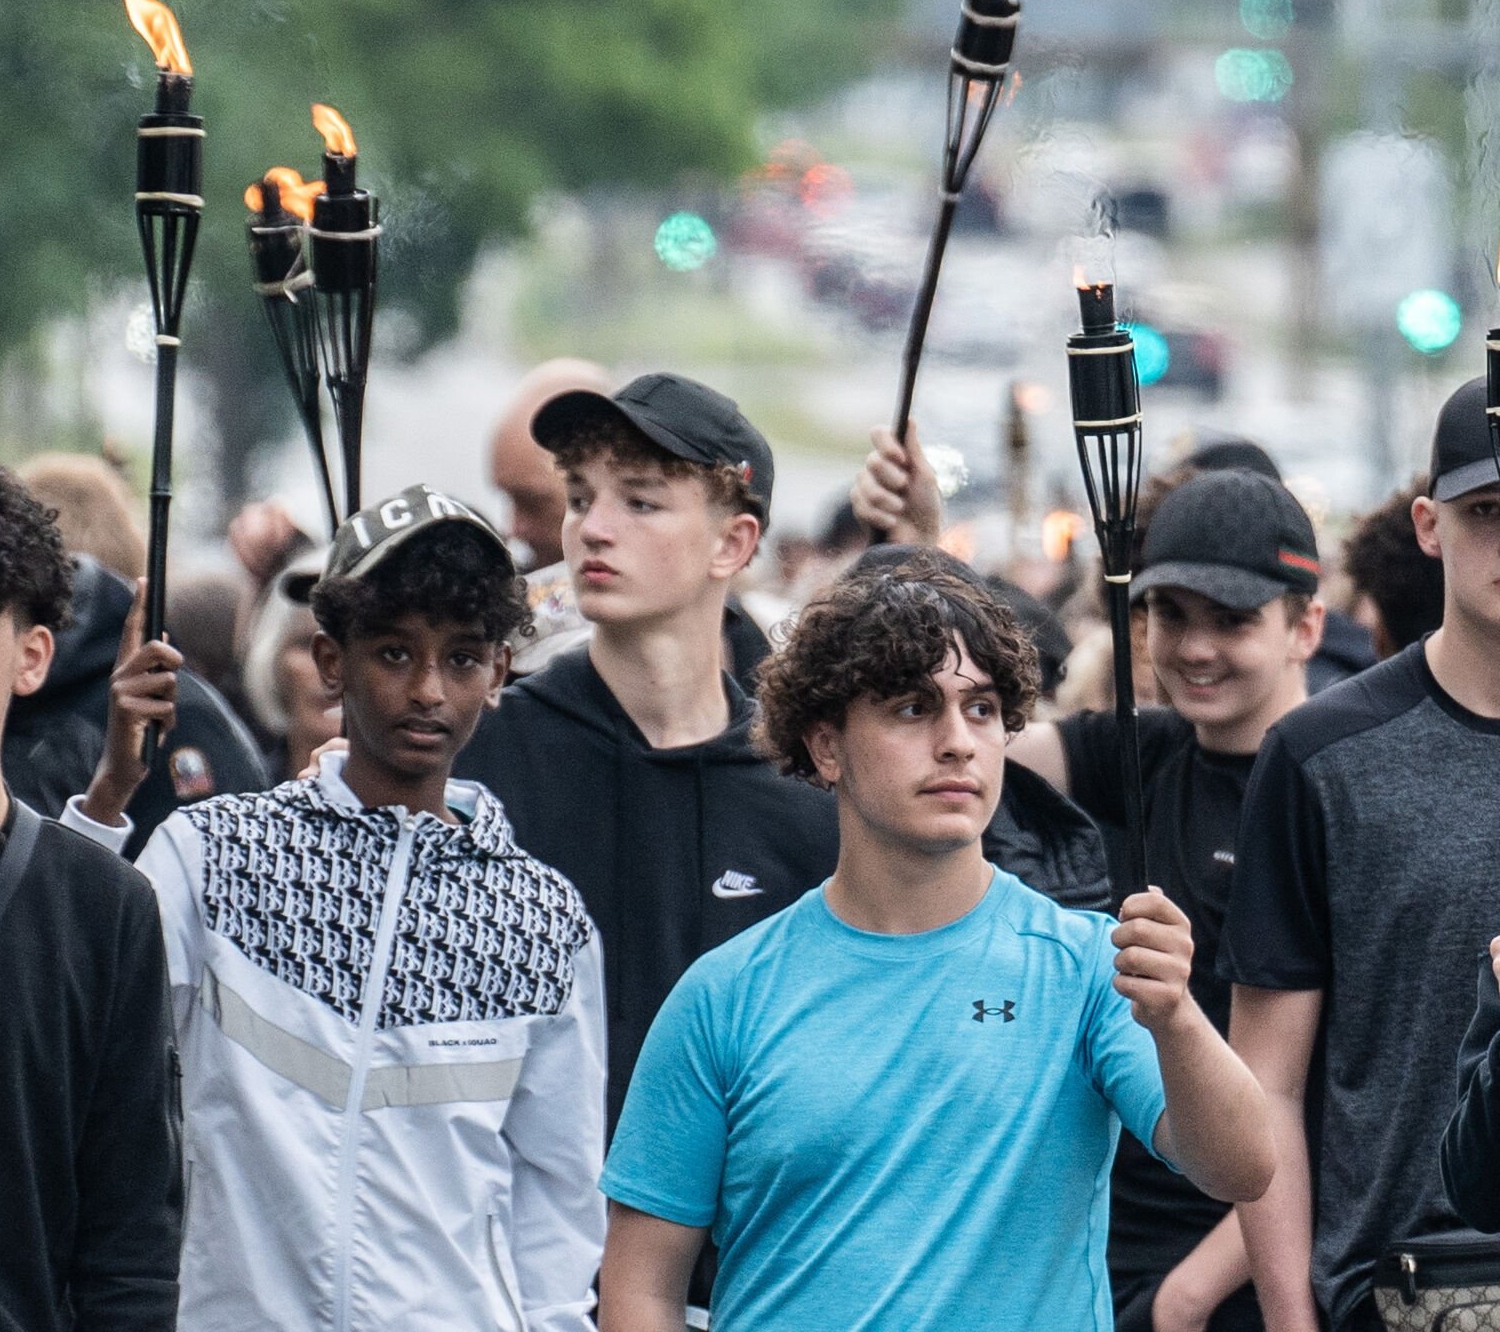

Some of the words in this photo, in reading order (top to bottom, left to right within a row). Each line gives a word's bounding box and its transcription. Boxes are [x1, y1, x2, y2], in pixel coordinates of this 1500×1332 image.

[721, 870, 757, 890] NIKE
[428, 1039, 460, 1047] BLACK
[467, 1037, 498, 1046] SQUAD
